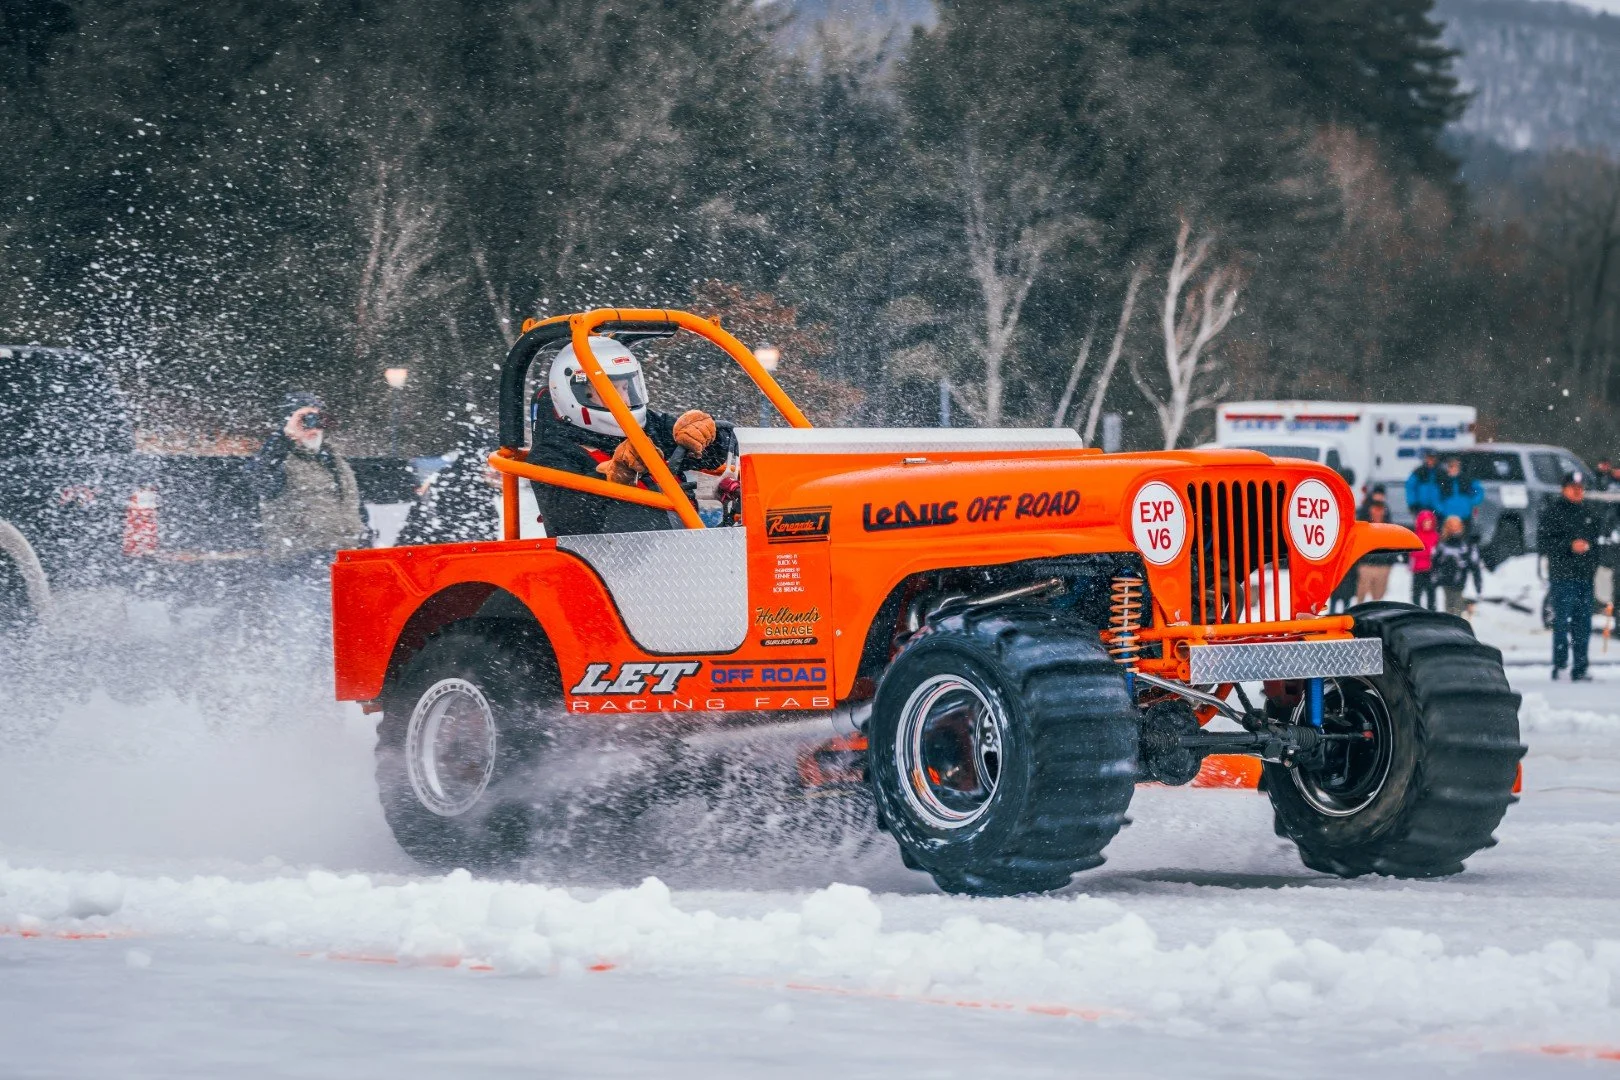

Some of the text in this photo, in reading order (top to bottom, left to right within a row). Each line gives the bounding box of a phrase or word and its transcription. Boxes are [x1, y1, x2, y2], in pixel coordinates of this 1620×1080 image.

[966, 495, 1012, 523] OFF
[1014, 489, 1081, 520] ROAD
[1139, 500, 1175, 523] EXP
[1297, 496, 1330, 520] EXP
[768, 515, 816, 535] Renegade
[1303, 524, 1325, 546] V6
[1148, 528, 1172, 550] V6
[765, 625, 813, 636] GARAGE
[571, 661, 827, 695] LET OFF ROAD
[572, 696, 831, 711] RACING FAB
